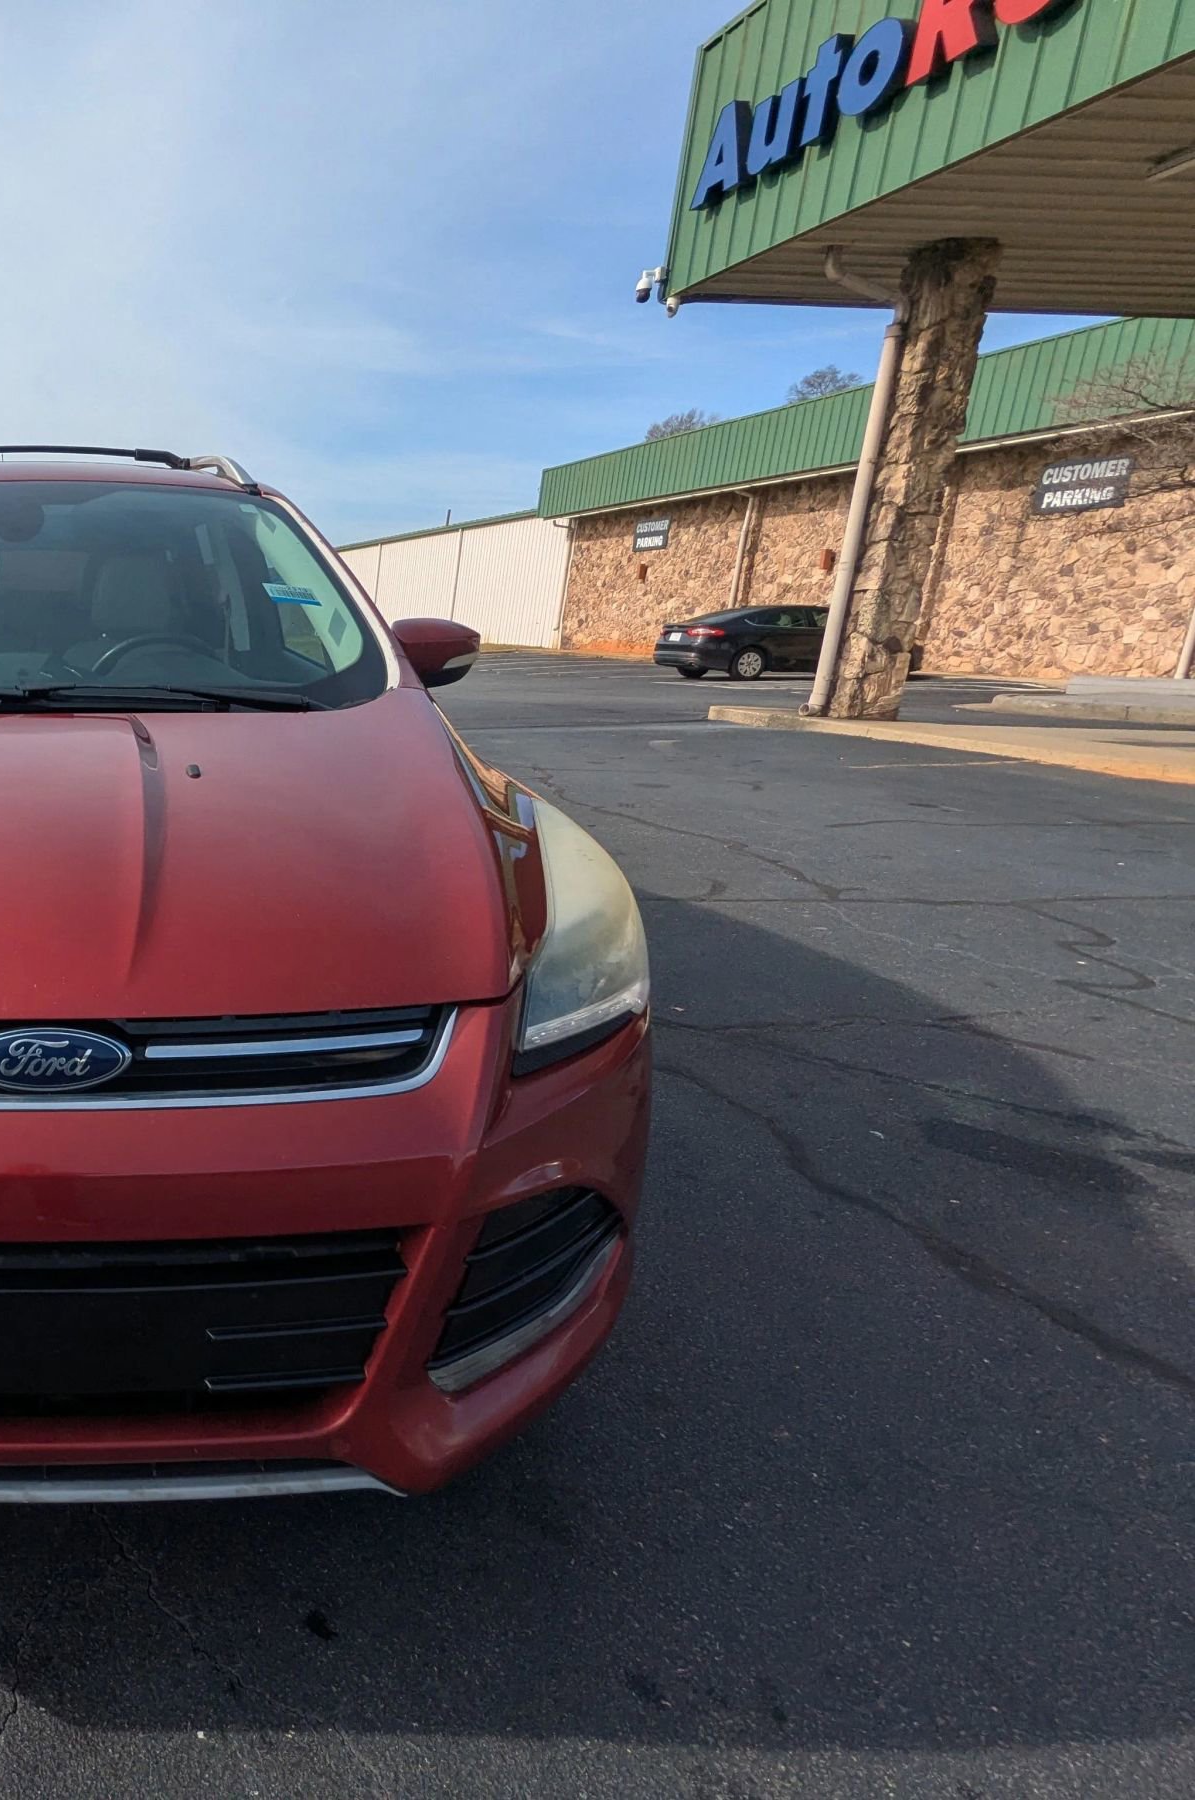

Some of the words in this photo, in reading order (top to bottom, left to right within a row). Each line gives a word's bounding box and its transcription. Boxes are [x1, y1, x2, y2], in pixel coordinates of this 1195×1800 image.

[1042, 458, 1130, 485] CUSTOMER
[1041, 486, 1115, 509] PARKING
[636, 519, 670, 533] CUSTOMER
[635, 535, 664, 549] PARKING
[0, 1038, 93, 1077] Ford
